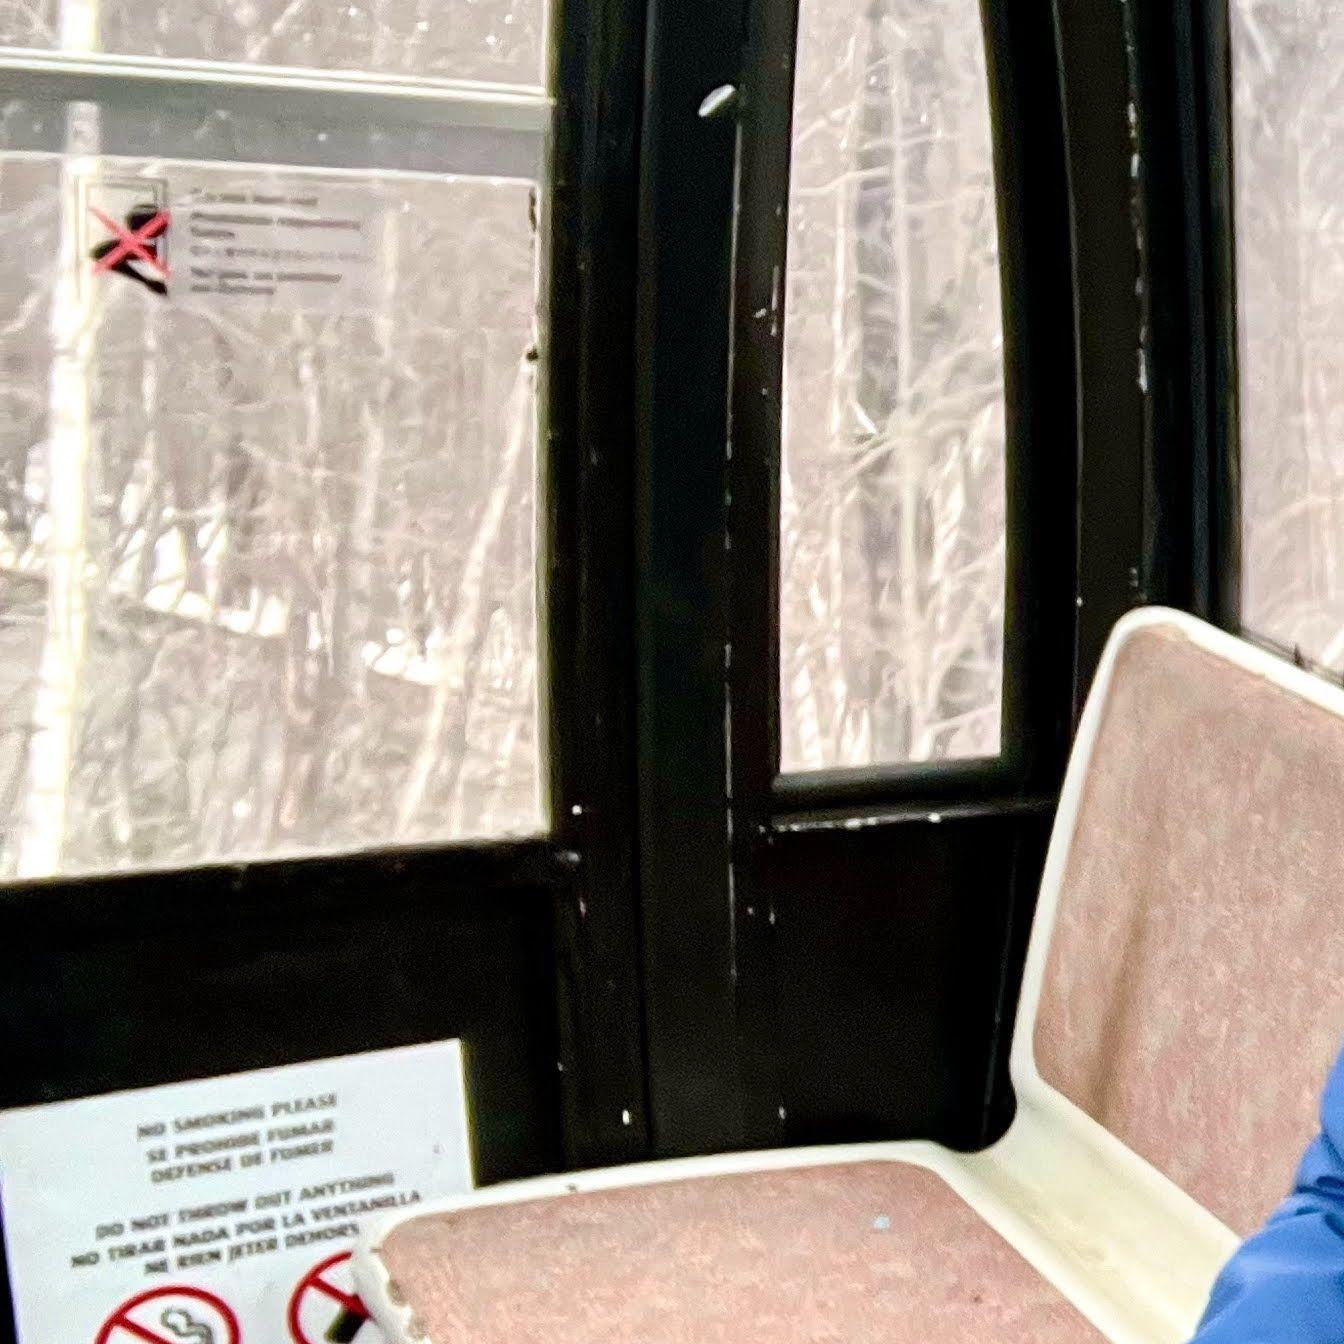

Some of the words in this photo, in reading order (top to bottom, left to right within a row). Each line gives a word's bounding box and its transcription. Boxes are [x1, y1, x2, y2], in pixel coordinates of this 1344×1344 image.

[137, 1122, 166, 1142] NO
[174, 1105, 265, 1133] SMOKING
[271, 1092, 337, 1117] PLEASE
[267, 1118, 334, 1142] FUMAR
[270, 1139, 333, 1162] FUMER
[71, 1251, 100, 1268] NO
[173, 1226, 229, 1247] NADA
[235, 1217, 275, 1236] POR
[282, 1212, 304, 1229] LA
[310, 1189, 420, 1222] VENTANILLA
[96, 1222, 124, 1240] DO
[131, 1212, 169, 1231] NOT
[179, 1199, 248, 1223] THROW
[254, 1190, 290, 1209] OUT
[300, 1173, 394, 1200] ANYTHING
